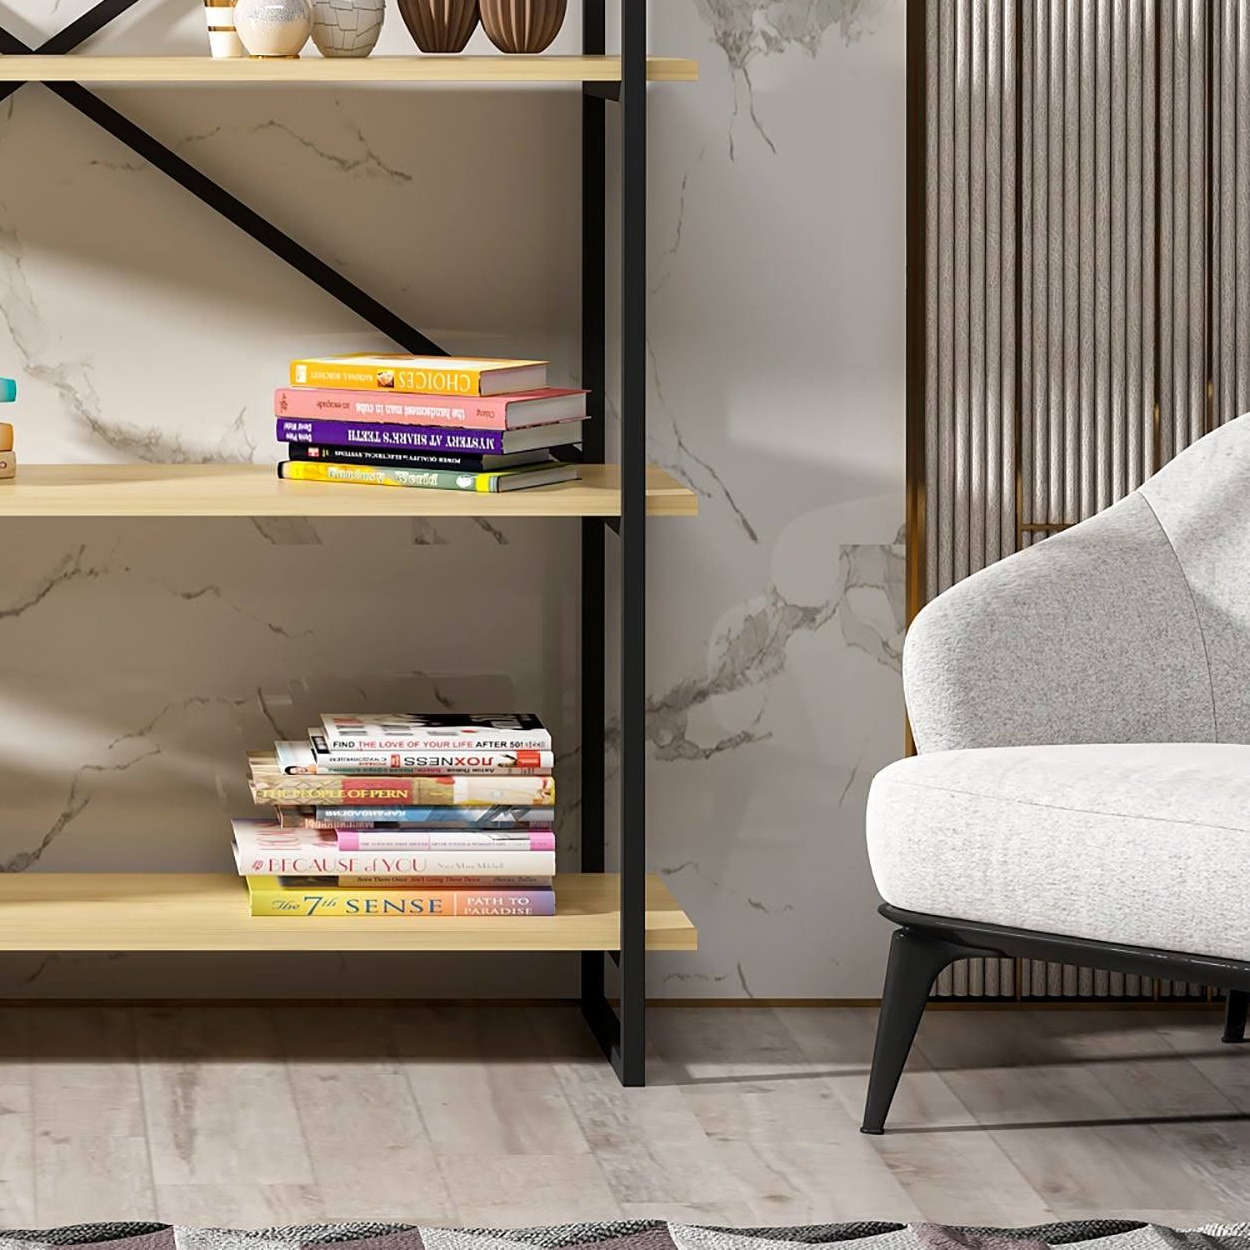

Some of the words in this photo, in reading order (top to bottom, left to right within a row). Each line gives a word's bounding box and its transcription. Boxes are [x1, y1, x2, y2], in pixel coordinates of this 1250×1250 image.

[399, 371, 471, 392] CHOICES
[347, 430, 381, 443] TEETH
[382, 431, 428, 446] SHARK'S
[430, 435, 443, 446] AT
[445, 435, 495, 450] MYSTERY
[363, 452, 402, 460] ELECTRICAL
[409, 455, 437, 463] QUALITY
[292, 789, 349, 799] PEOPLE
[348, 789, 367, 799] OF
[368, 789, 410, 799] PERN
[269, 858, 359, 872] BECAUSE
[364, 858, 378, 872] of
[382, 858, 427, 872] YOU
[270, 900, 301, 910] The
[303, 896, 340, 916] 7th
[345, 899, 443, 913] SENSE
[467, 897, 503, 905] PATH
[508, 897, 529, 905] TO
